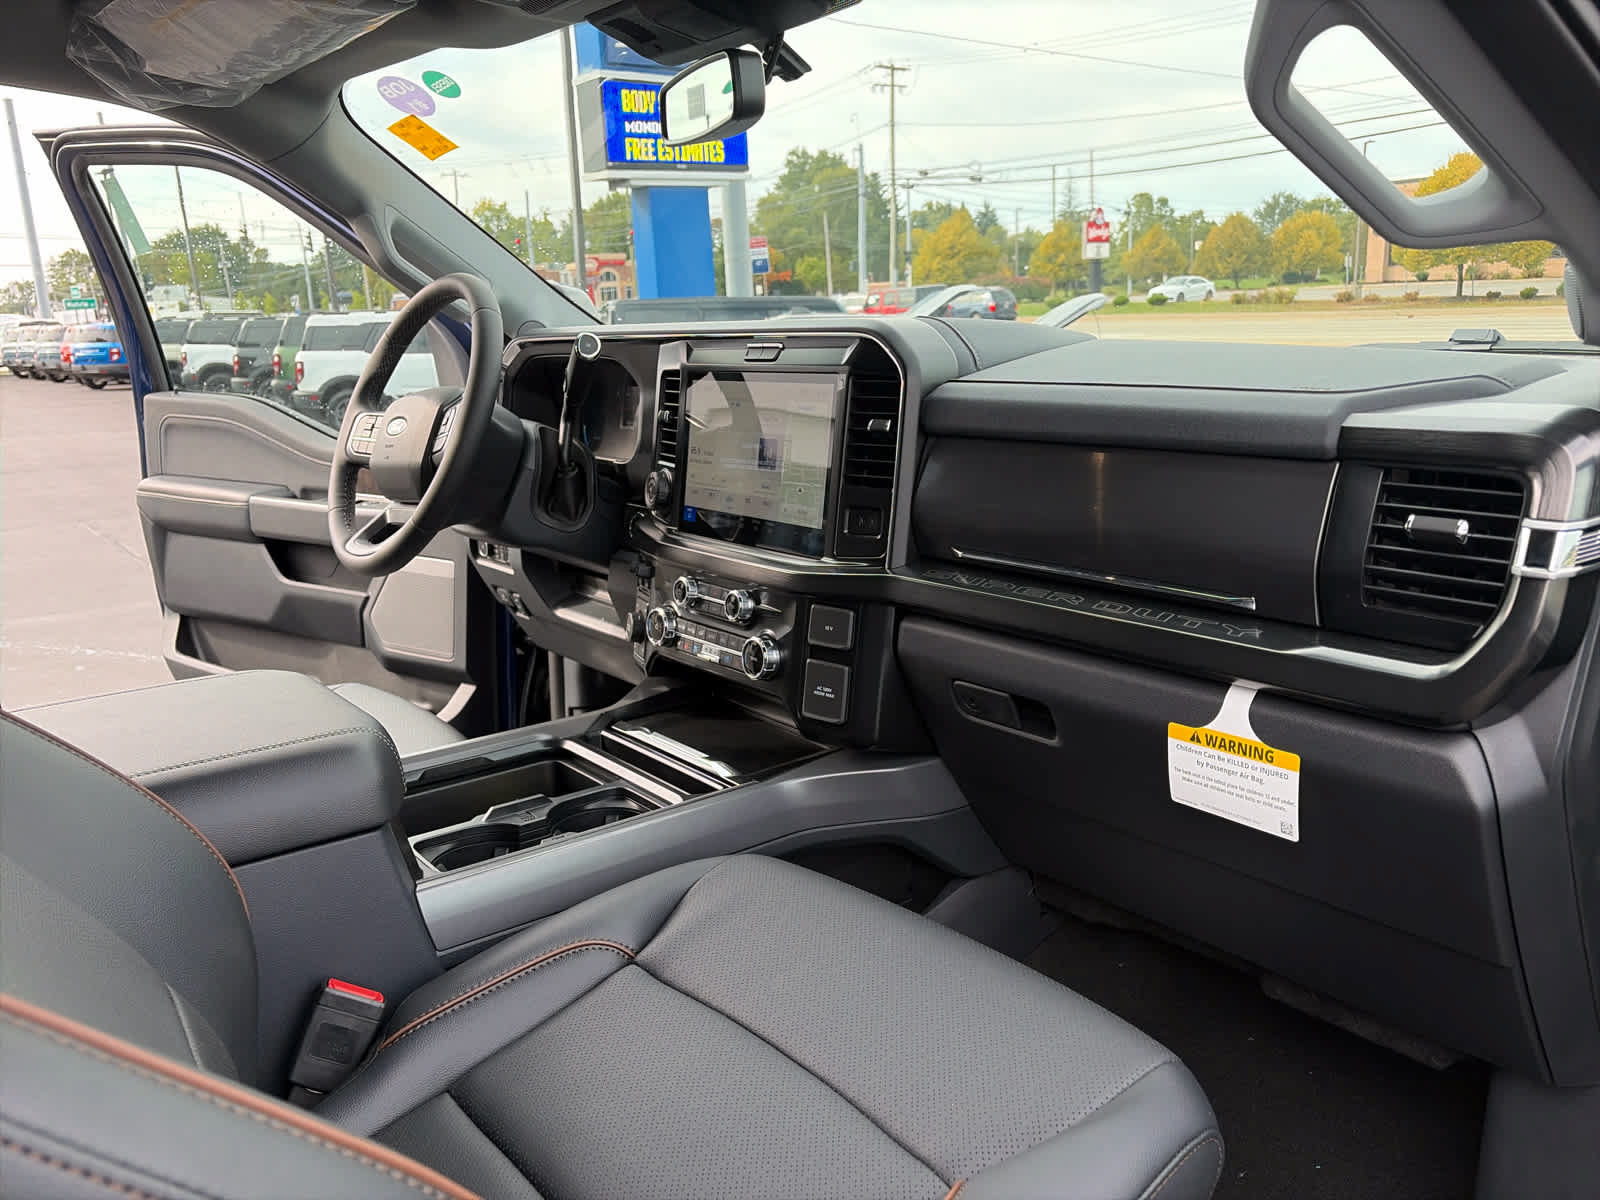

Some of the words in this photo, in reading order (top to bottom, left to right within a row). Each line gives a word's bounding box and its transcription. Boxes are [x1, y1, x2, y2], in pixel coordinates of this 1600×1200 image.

[621, 89, 655, 113] BODY
[624, 120, 662, 134] MOND
[625, 137, 656, 161] FREE
[657, 138, 725, 163] ESTIMATES
[1091, 600, 1264, 638] DUTY
[1204, 733, 1275, 763] WARNING
[1176, 744, 1202, 756] Children
[1203, 751, 1216, 760] Can
[1227, 757, 1250, 769] KILLED
[1259, 767, 1289, 780] INJURED
[1196, 759, 1204, 769] by
[1205, 762, 1238, 777] Passenger
[1240, 771, 1249, 780] Air
[1251, 774, 1265, 785] Bag.
